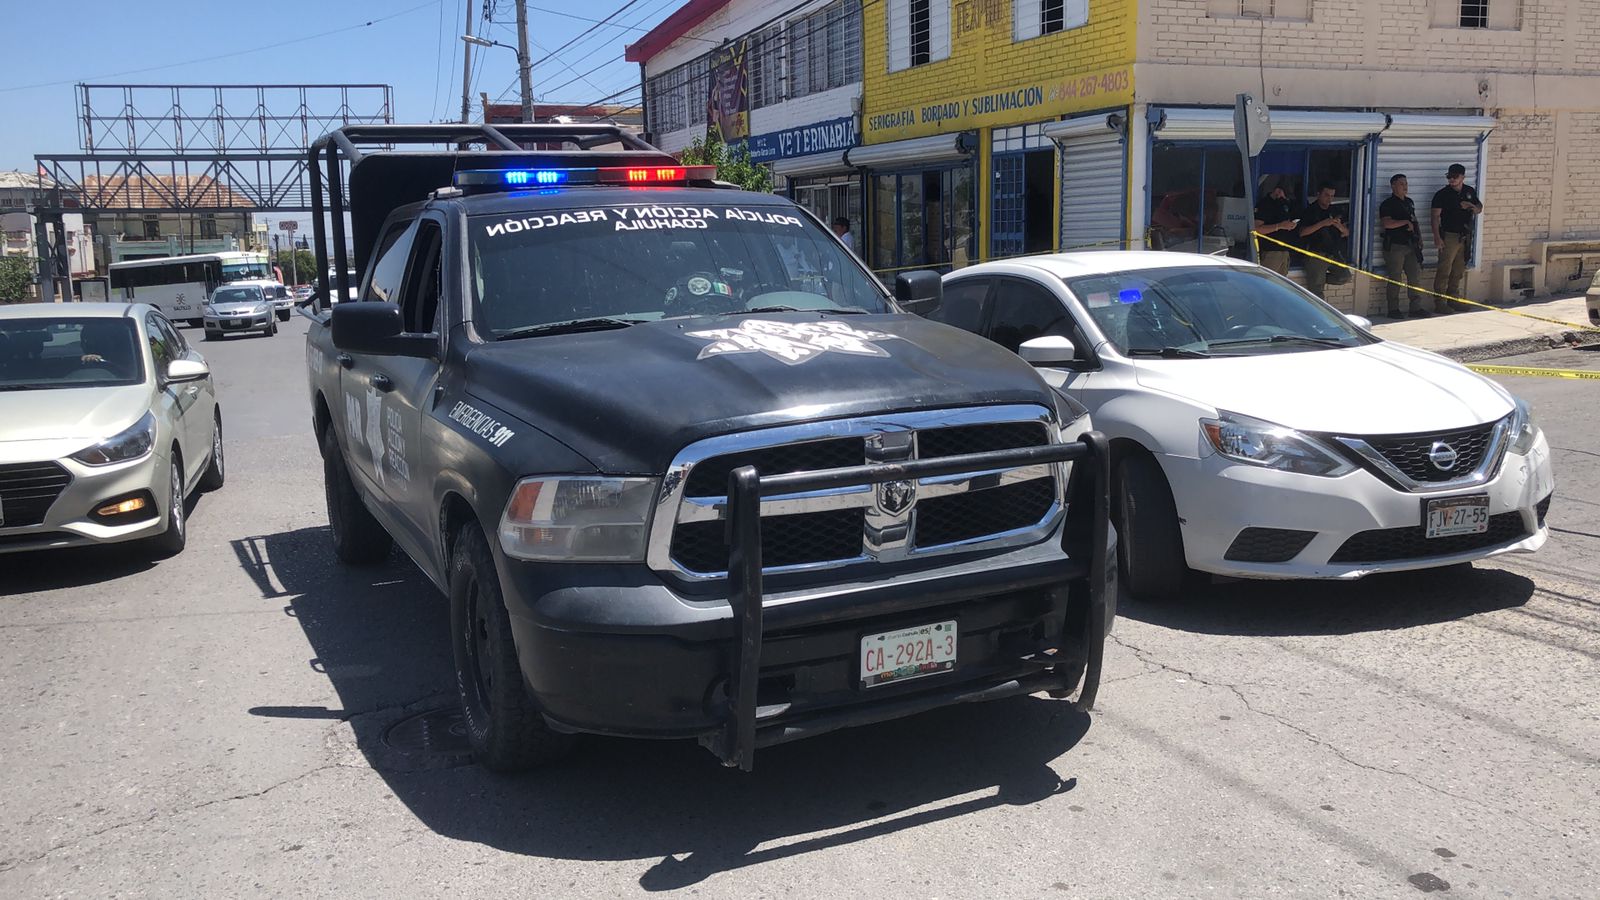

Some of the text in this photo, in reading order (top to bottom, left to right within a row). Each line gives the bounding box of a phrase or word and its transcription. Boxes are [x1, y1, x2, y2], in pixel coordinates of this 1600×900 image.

[869, 107, 915, 131] SERIGRAFÍA
[922, 101, 960, 123] BORDADO
[964, 99, 969, 116] Y
[972, 84, 1043, 115] SUBLIMACIÓN
[779, 120, 856, 156] VETERINARIA
[448, 401, 515, 447] EMERGENCIAS 911
[866, 635, 954, 672] CA-292A-3
